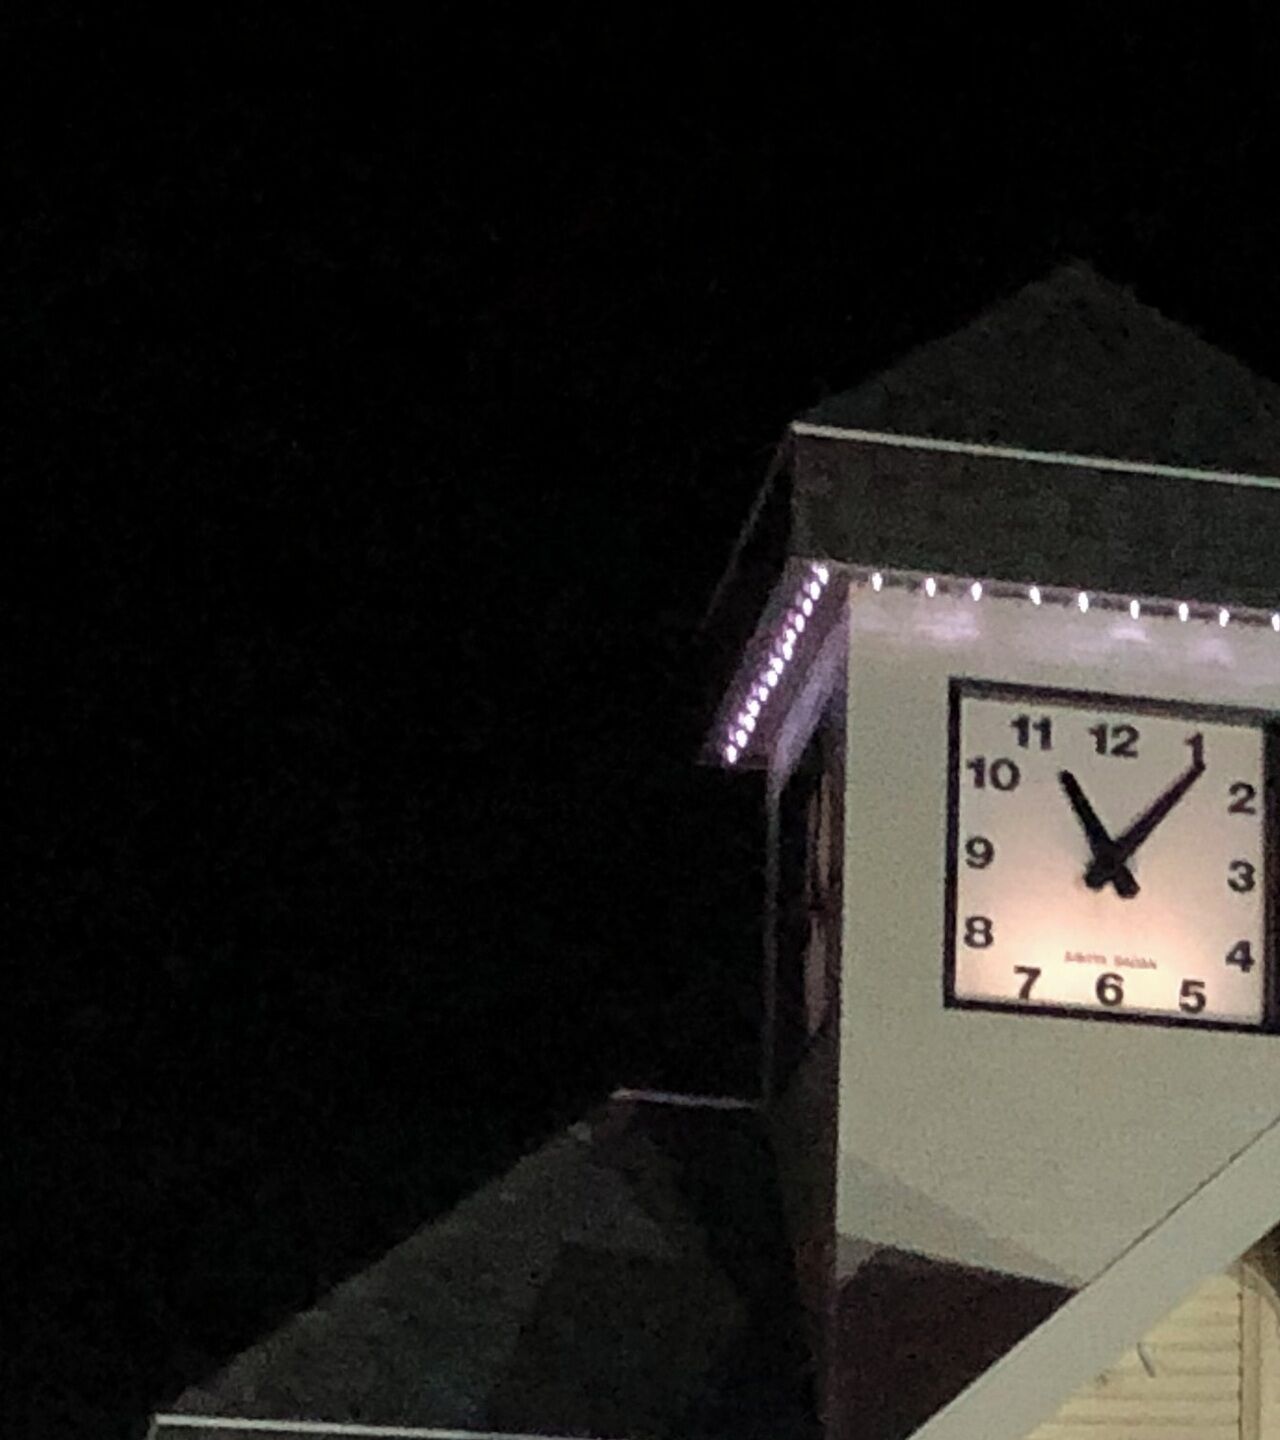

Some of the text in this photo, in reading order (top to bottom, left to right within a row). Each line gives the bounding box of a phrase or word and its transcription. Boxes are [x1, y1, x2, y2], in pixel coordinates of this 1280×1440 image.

[1011, 715, 1052, 751] 11
[1089, 724, 1140, 759] 12
[1184, 732, 1205, 767] 1
[966, 756, 1022, 792] 10
[1227, 781, 1257, 816] 2
[964, 835, 995, 870] 9
[1226, 859, 1256, 895] 3
[963, 915, 994, 949] 8
[1225, 939, 1255, 973] 4
[1013, 965, 1042, 1000] 7
[1095, 972, 1124, 1007] 6
[1179, 979, 1207, 1014] 5
